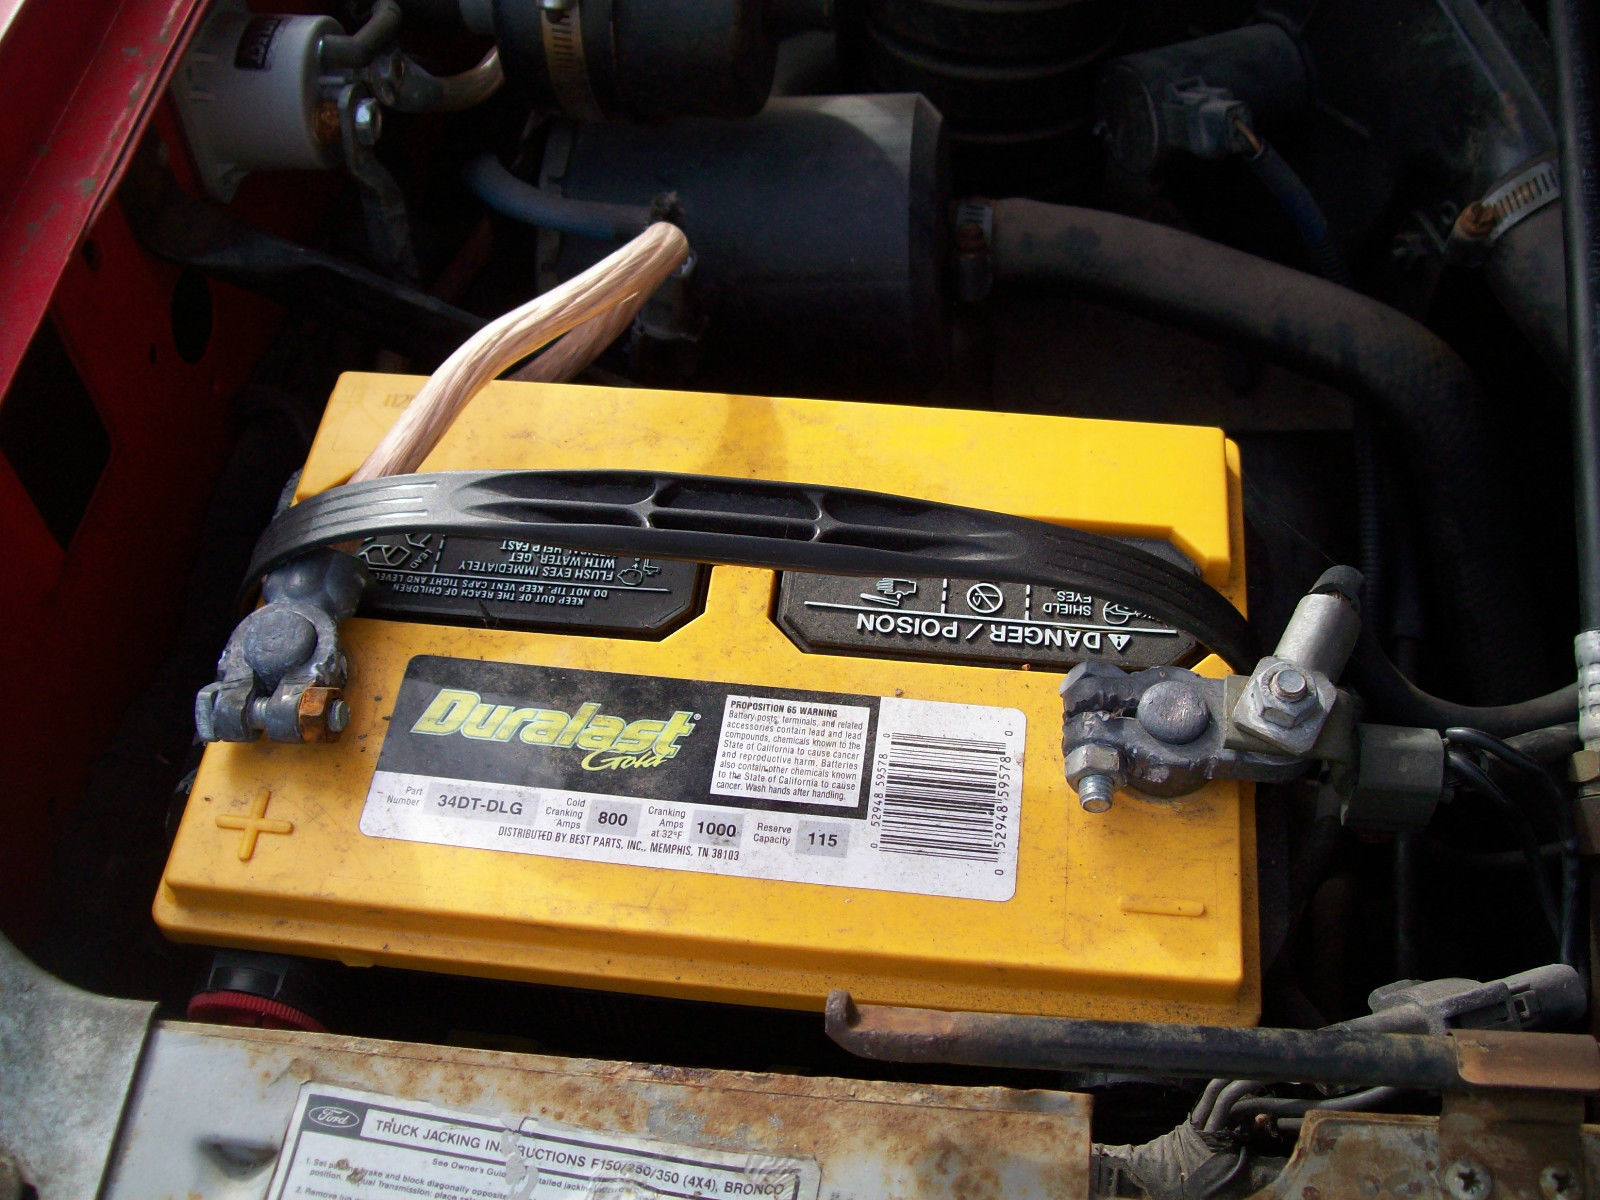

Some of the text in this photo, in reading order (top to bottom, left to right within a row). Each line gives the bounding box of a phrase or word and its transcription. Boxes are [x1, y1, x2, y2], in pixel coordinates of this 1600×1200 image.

[499, 539, 529, 551] FAST
[409, 549, 431, 569] LEAD
[509, 551, 615, 570] WITH WATER. GET
[458, 559, 614, 582] FLUSH EYES IMMEDIATELY
[374, 572, 608, 598] DO NOT TIP. KEEP VENT CAPS TIGHT AND LEVEL
[392, 582, 584, 605] KEEP OUT OF THE REACH OF CHILDREN
[1056, 590, 1092, 603] EYES
[1042, 601, 1092, 617] SHIELD
[856, 613, 959, 637] POISON
[989, 624, 1101, 650] DANGER
[730, 700, 838, 718] PROPOSITION 65 WARNING
[409, 688, 697, 759] Duralast
[728, 710, 756, 722] Battery
[782, 715, 820, 728] terminals,
[821, 719, 836, 728] and
[837, 720, 863, 730] related
[726, 720, 862, 740] accessories contain lead and lead
[724, 730, 861, 750] compounds, chemicals known to the
[581, 747, 667, 771] Gold
[723, 740, 860, 760] State of California to cause cancer
[721, 750, 858, 770] and reproductive harm. Batteries
[720, 760, 857, 780] also contain other chemicals known
[728, 771, 742, 780] the
[744, 772, 766, 782] State
[767, 775, 777, 783] of
[778, 775, 819, 787] California
[821, 780, 829, 788] to
[831, 782, 856, 790] cause
[405, 786, 424, 796] Part
[716, 782, 846, 802] cancer. Wash hands after handling.
[386, 795, 421, 807] Number
[436, 794, 524, 816] 34DT-DLG
[565, 797, 586, 808] Cold
[544, 806, 584, 821] Cranking
[597, 811, 629, 827] 800
[647, 805, 687, 820] Cranking
[555, 819, 582, 831] Amps
[651, 829, 662, 838] at
[659, 818, 685, 831] Amps
[695, 821, 738, 838] 1000
[756, 822, 792, 835] Reserve
[497, 826, 554, 842] DISTRIBUTED
[554, 832, 568, 843] BY
[568, 833, 592, 846] BEST
[592, 836, 625, 851] PARTS,
[649, 842, 695, 858] MEMPHIS,
[697, 847, 711, 858] TN
[711, 848, 740, 861] 38103
[752, 832, 791, 847] Capacity
[807, 832, 838, 848] 115
[318, 1107, 350, 1127] Ford
[376, 1119, 418, 1138] TRUCK
[423, 1127, 480, 1149] JACKING
[485, 1139, 585, 1169] INRUCTIONS
[724, 1181, 785, 1195] BRONCO
[432, 1157, 450, 1168] See
[451, 1161, 484, 1175] Owner's
[385, 1172, 400, 1182] and
[403, 1175, 425, 1186] block
[427, 1179, 470, 1196] diagonally
